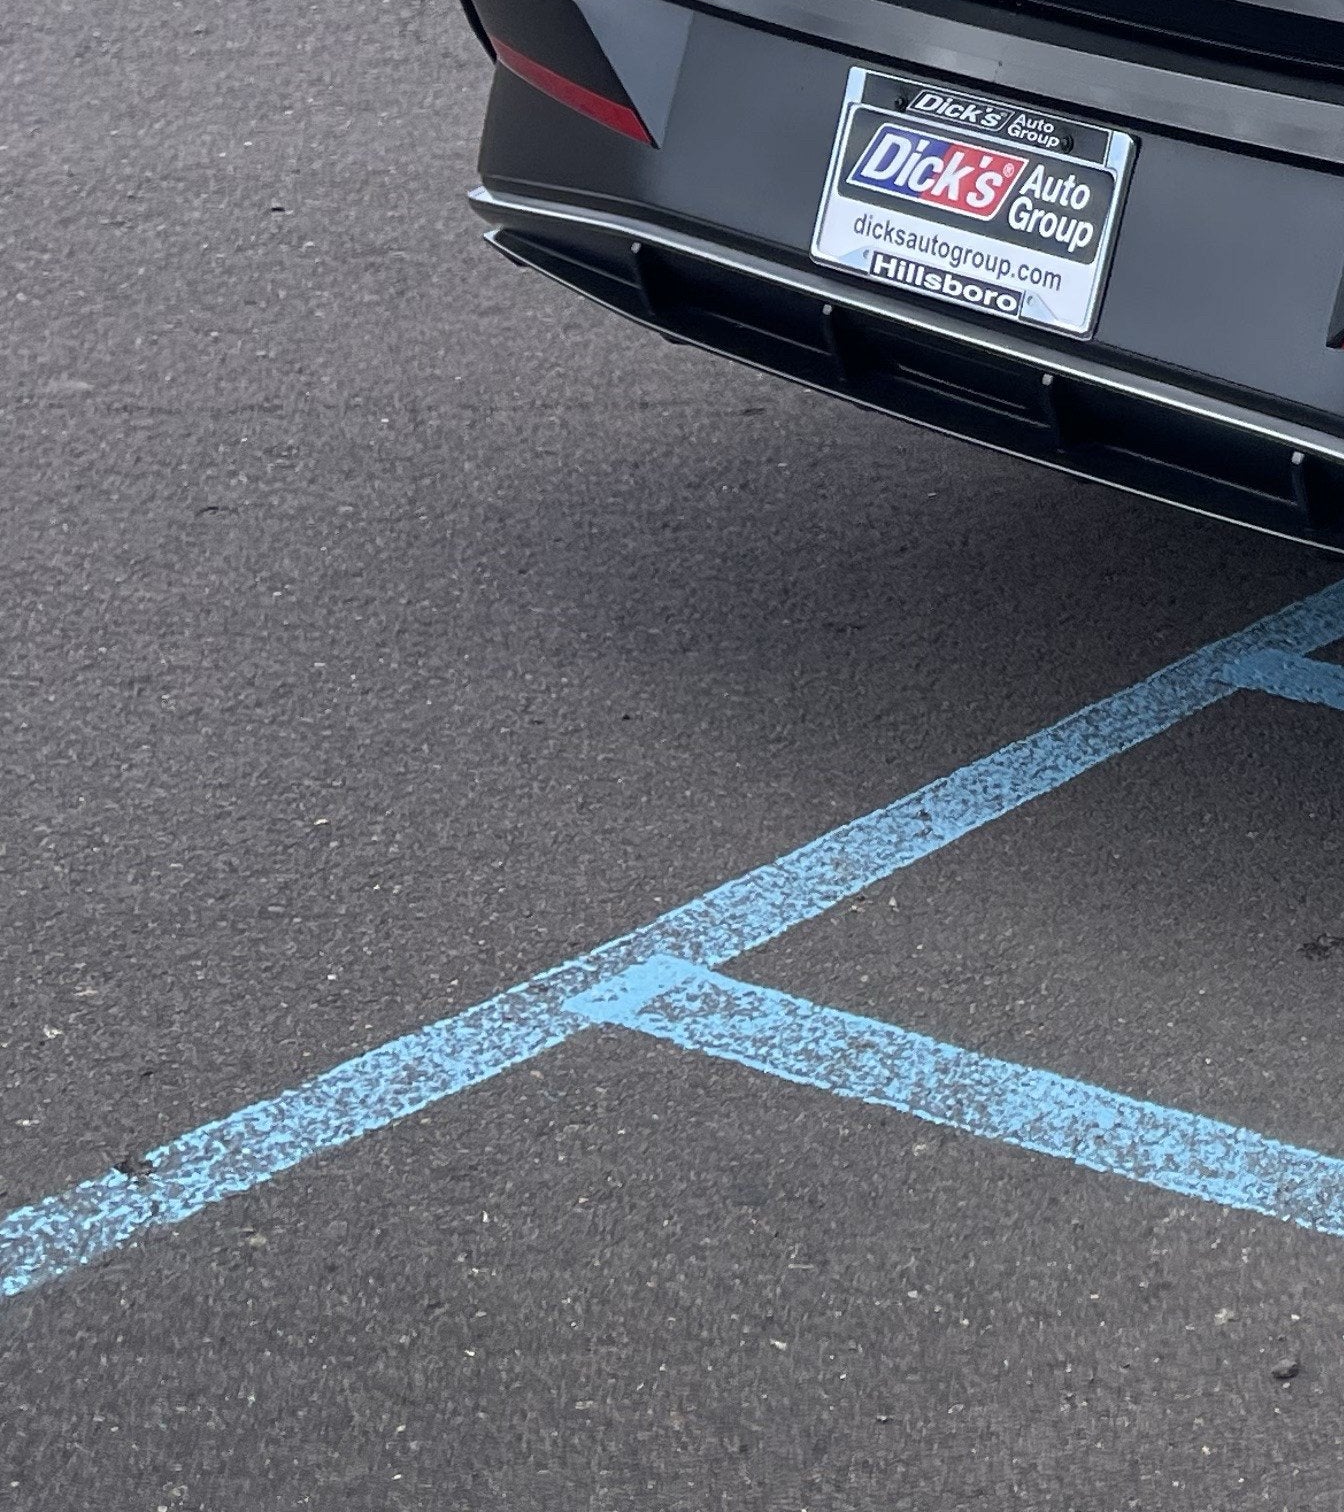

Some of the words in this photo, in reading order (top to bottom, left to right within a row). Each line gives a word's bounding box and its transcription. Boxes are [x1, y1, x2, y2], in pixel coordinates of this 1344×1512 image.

[1007, 125, 1060, 150] Group
[1013, 114, 1056, 134] Auto
[1019, 165, 1091, 211] Auto
[1008, 198, 1094, 253] Group
[853, 213, 1063, 292] dicksautogroup.com
[872, 254, 1019, 313] Hillsboro
